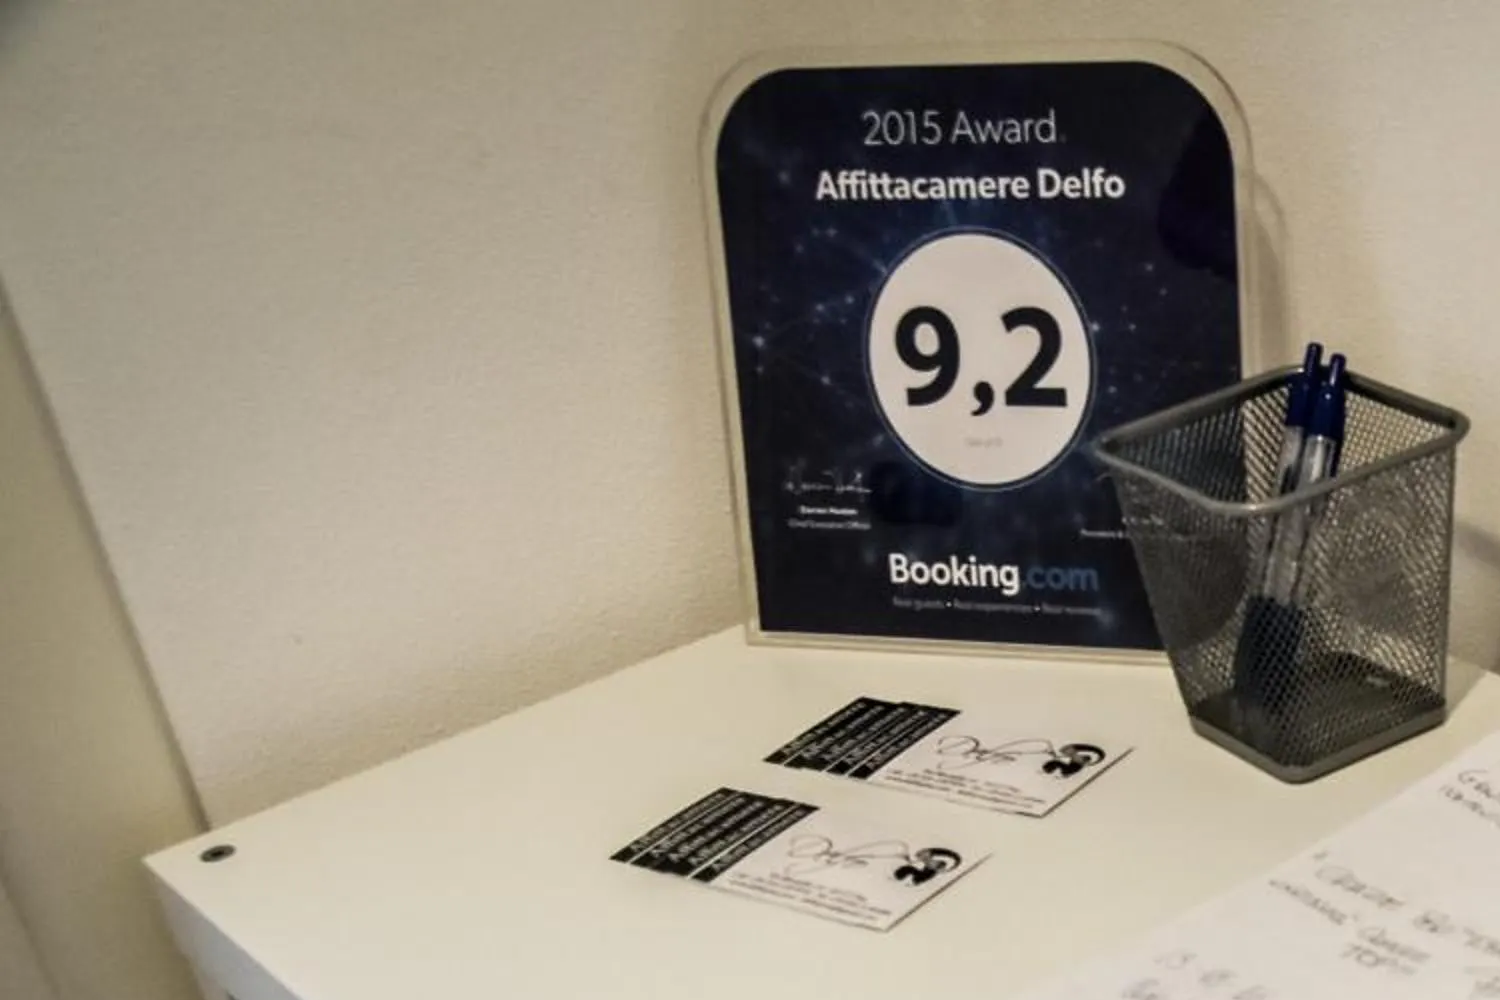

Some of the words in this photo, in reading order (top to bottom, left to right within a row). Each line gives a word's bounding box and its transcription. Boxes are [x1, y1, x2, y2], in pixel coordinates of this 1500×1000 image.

[861, 109, 942, 146] 2015
[950, 108, 1057, 145] Award
[815, 169, 1030, 201] Affittacamere
[1036, 166, 1126, 200] Delfo
[894, 306, 1068, 416] 9,2
[888, 552, 1100, 596] Booking.com
